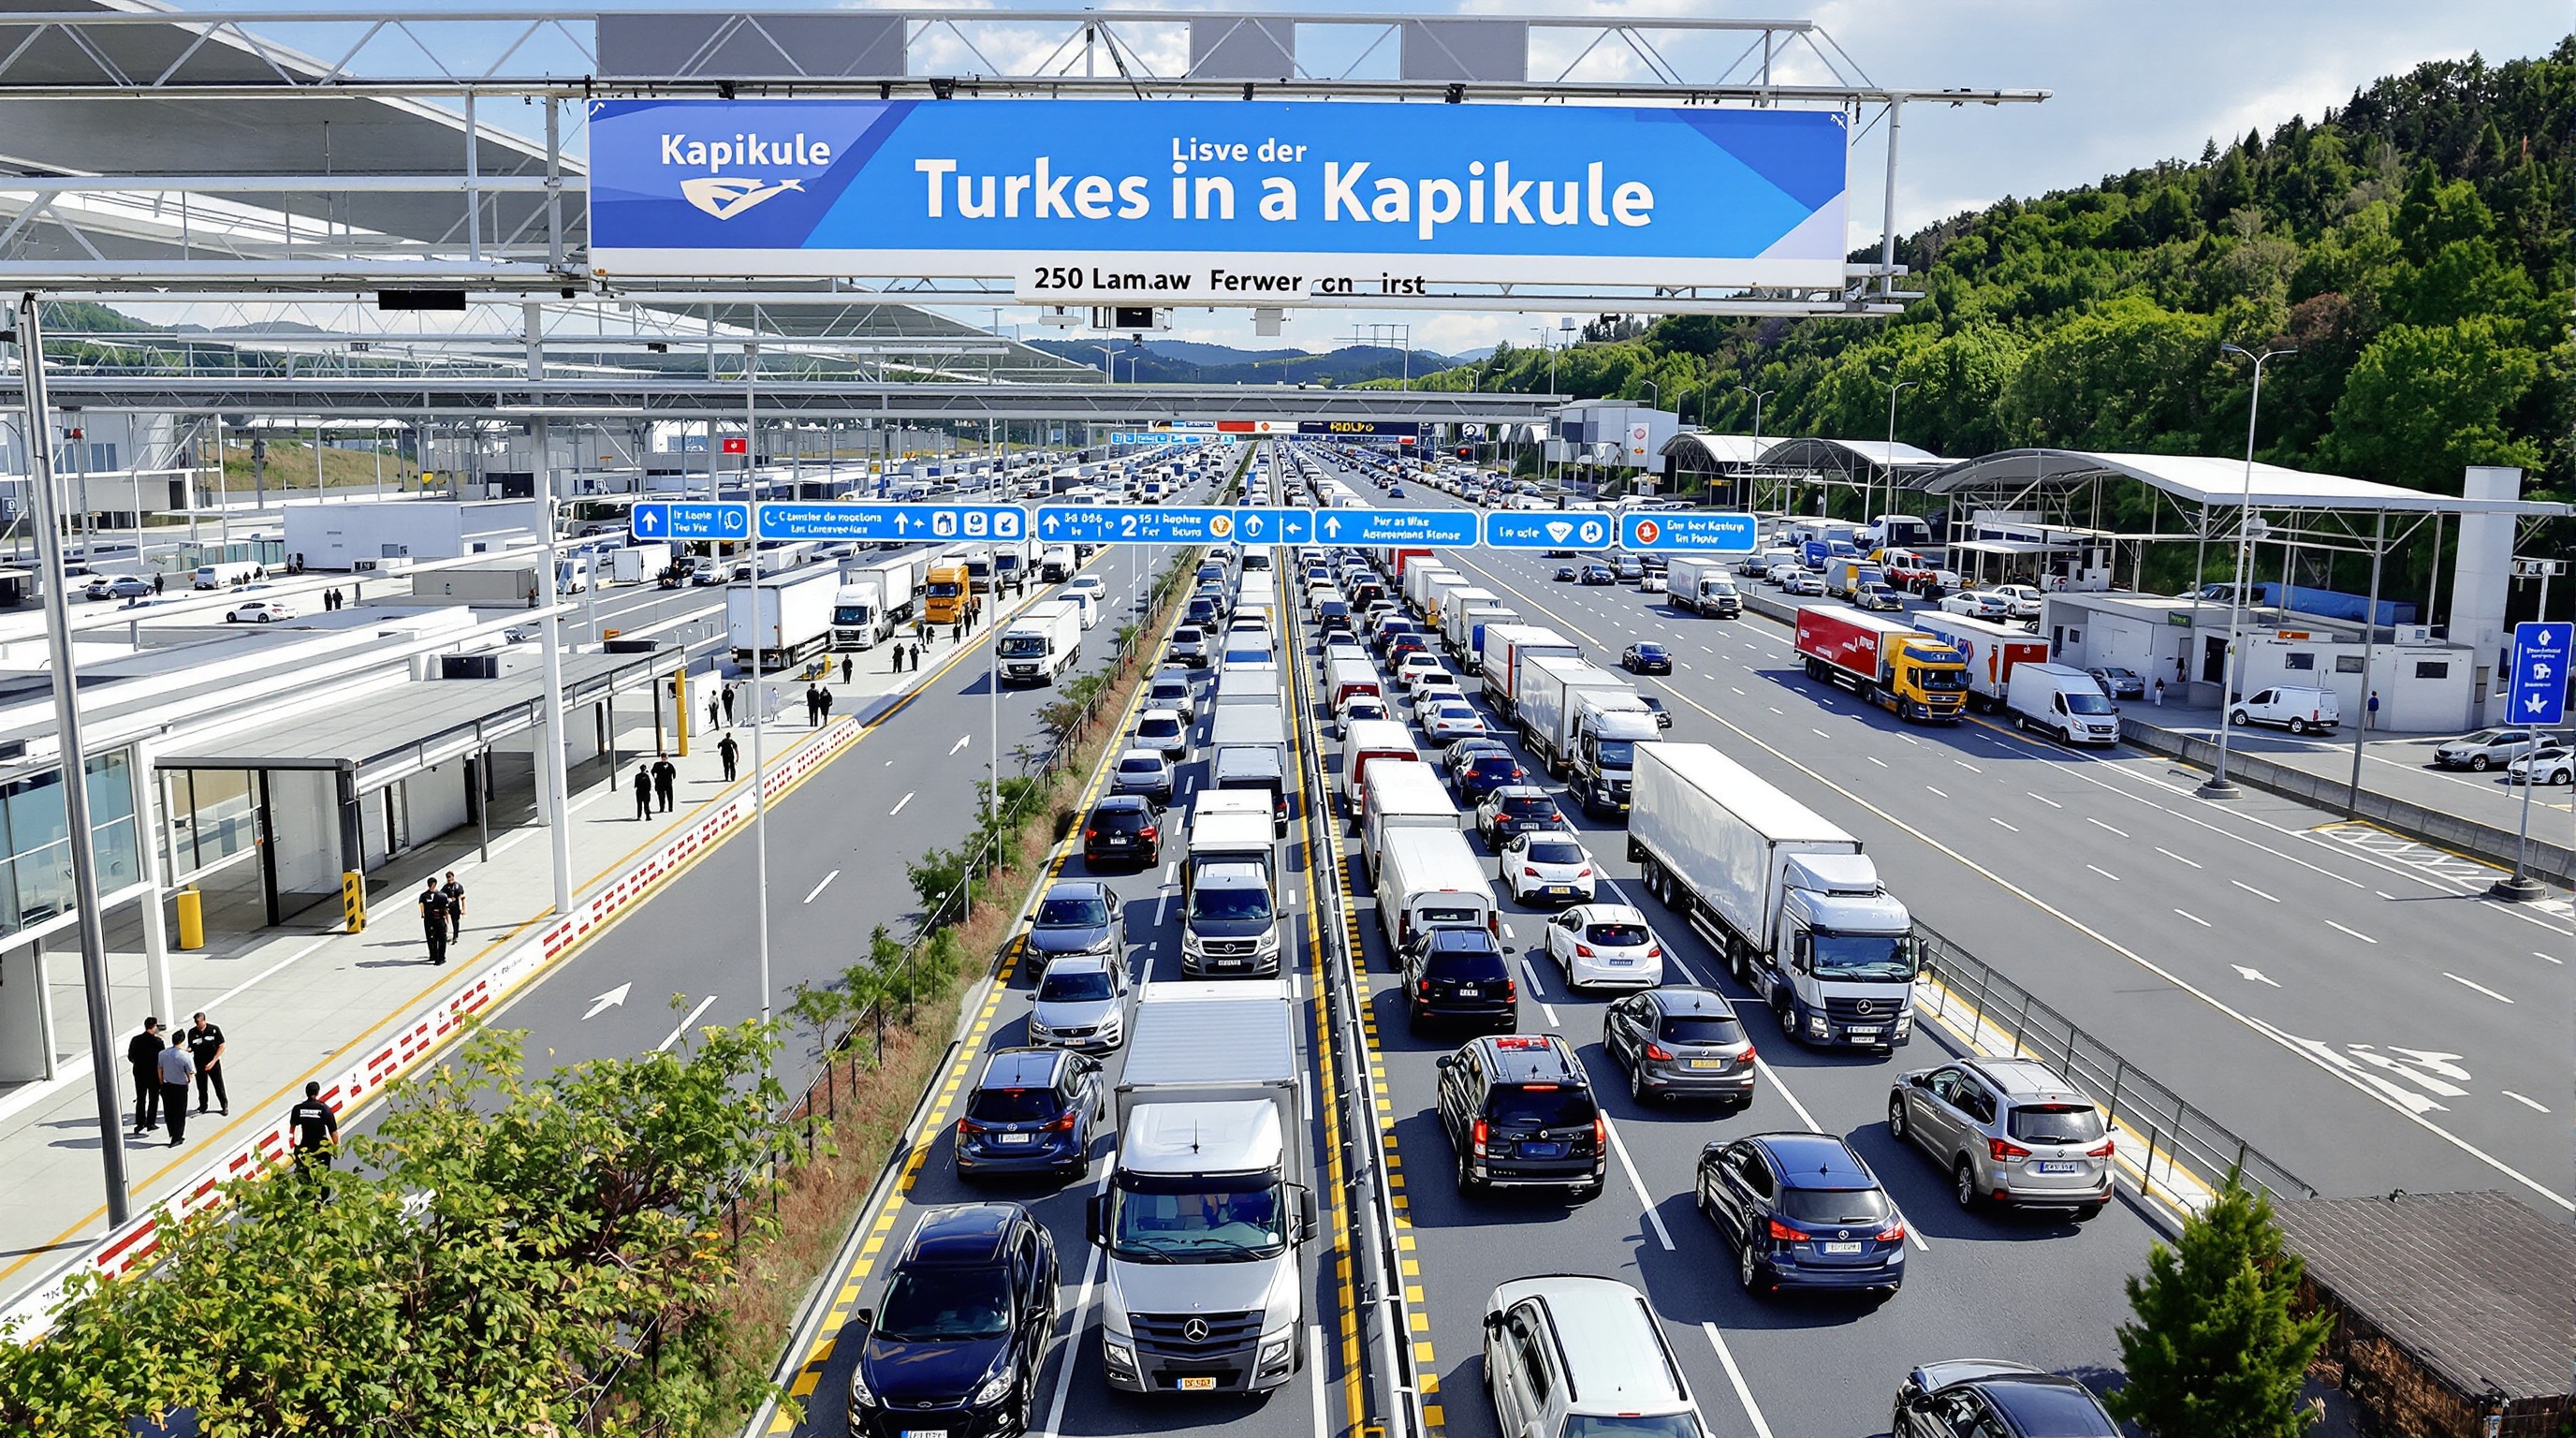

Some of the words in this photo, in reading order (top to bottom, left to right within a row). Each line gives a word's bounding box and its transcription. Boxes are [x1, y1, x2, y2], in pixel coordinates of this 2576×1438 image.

[662, 133, 830, 173] Kapikule
[1173, 137, 1248, 161] Lisve
[1257, 137, 1307, 162] der
[915, 156, 1150, 219] Turkes
[1172, 161, 1235, 219] in
[1259, 176, 1297, 221] a
[1324, 160, 1654, 240] Kapikule
[1034, 267, 1083, 289] 250
[1210, 269, 1303, 291] Ferwer
[1120, 514, 1137, 537] 2
